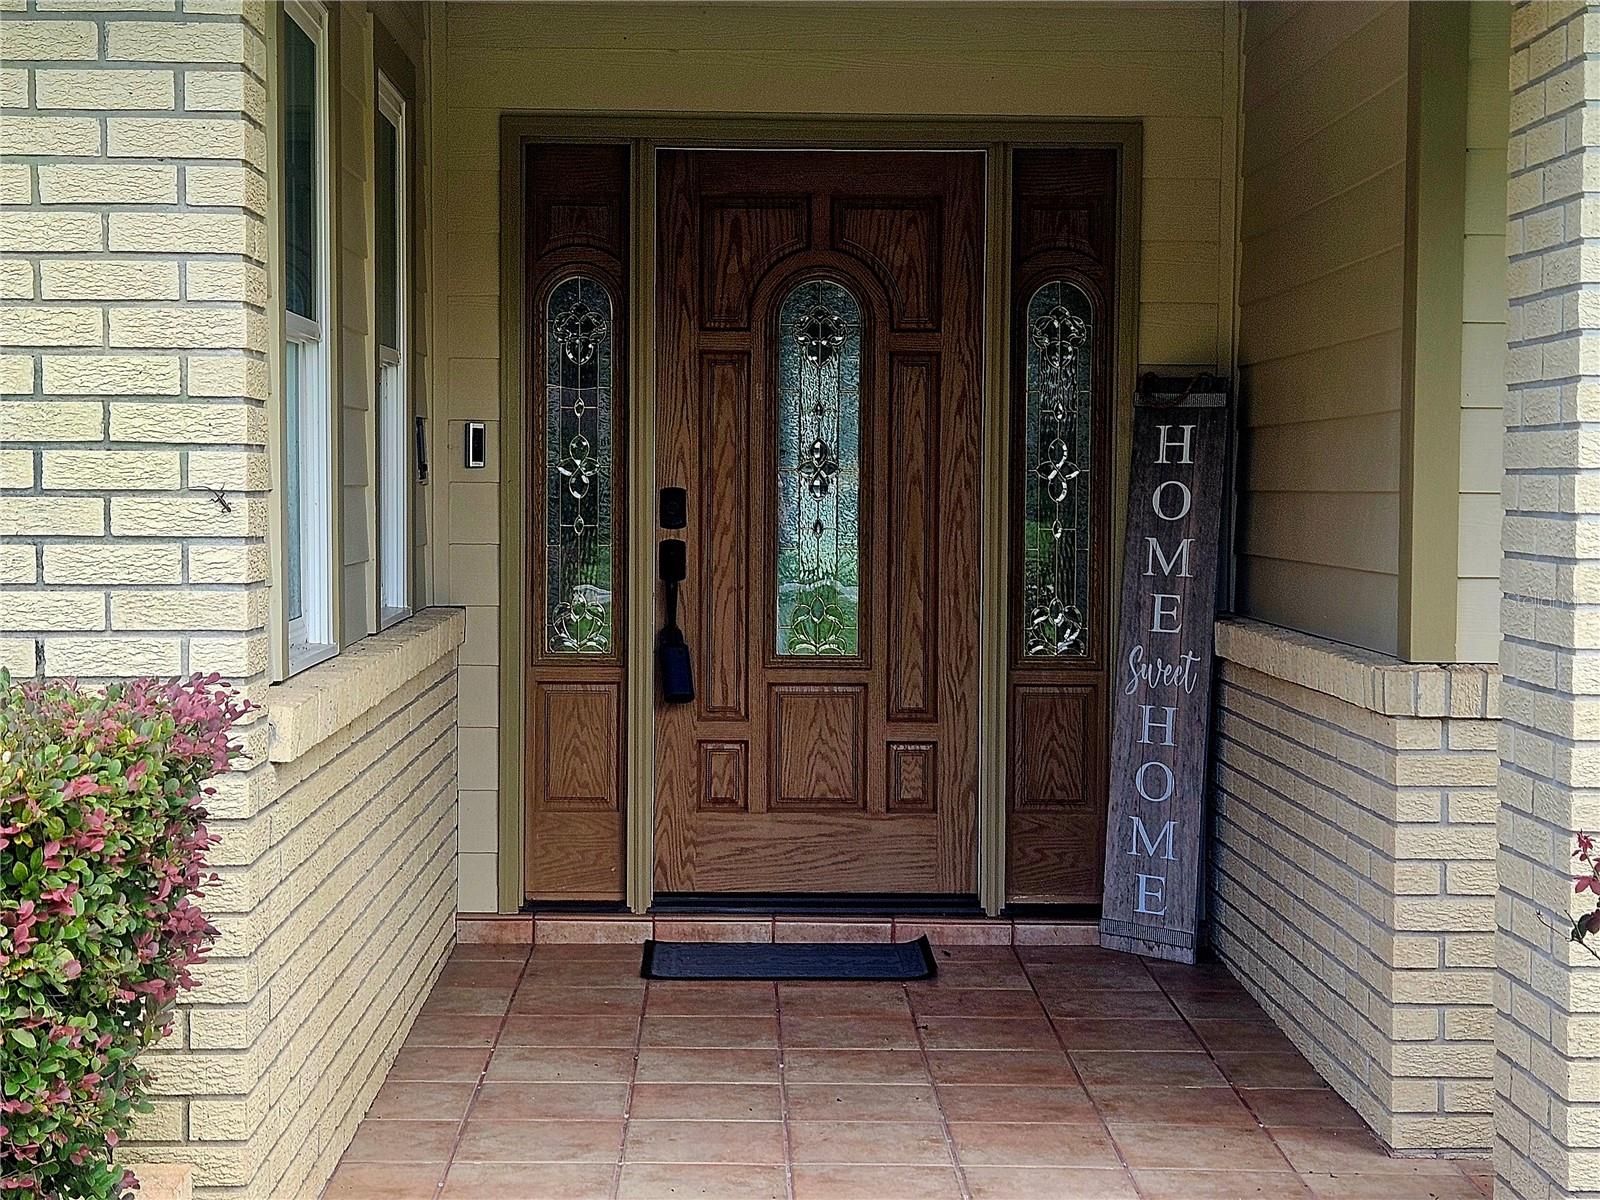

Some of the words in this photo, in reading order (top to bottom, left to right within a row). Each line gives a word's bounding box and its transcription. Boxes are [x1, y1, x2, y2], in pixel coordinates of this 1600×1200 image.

[1142, 424, 1197, 633] HOME
[1125, 644, 1201, 695] Sweet
[1126, 704, 1179, 916] HOME
